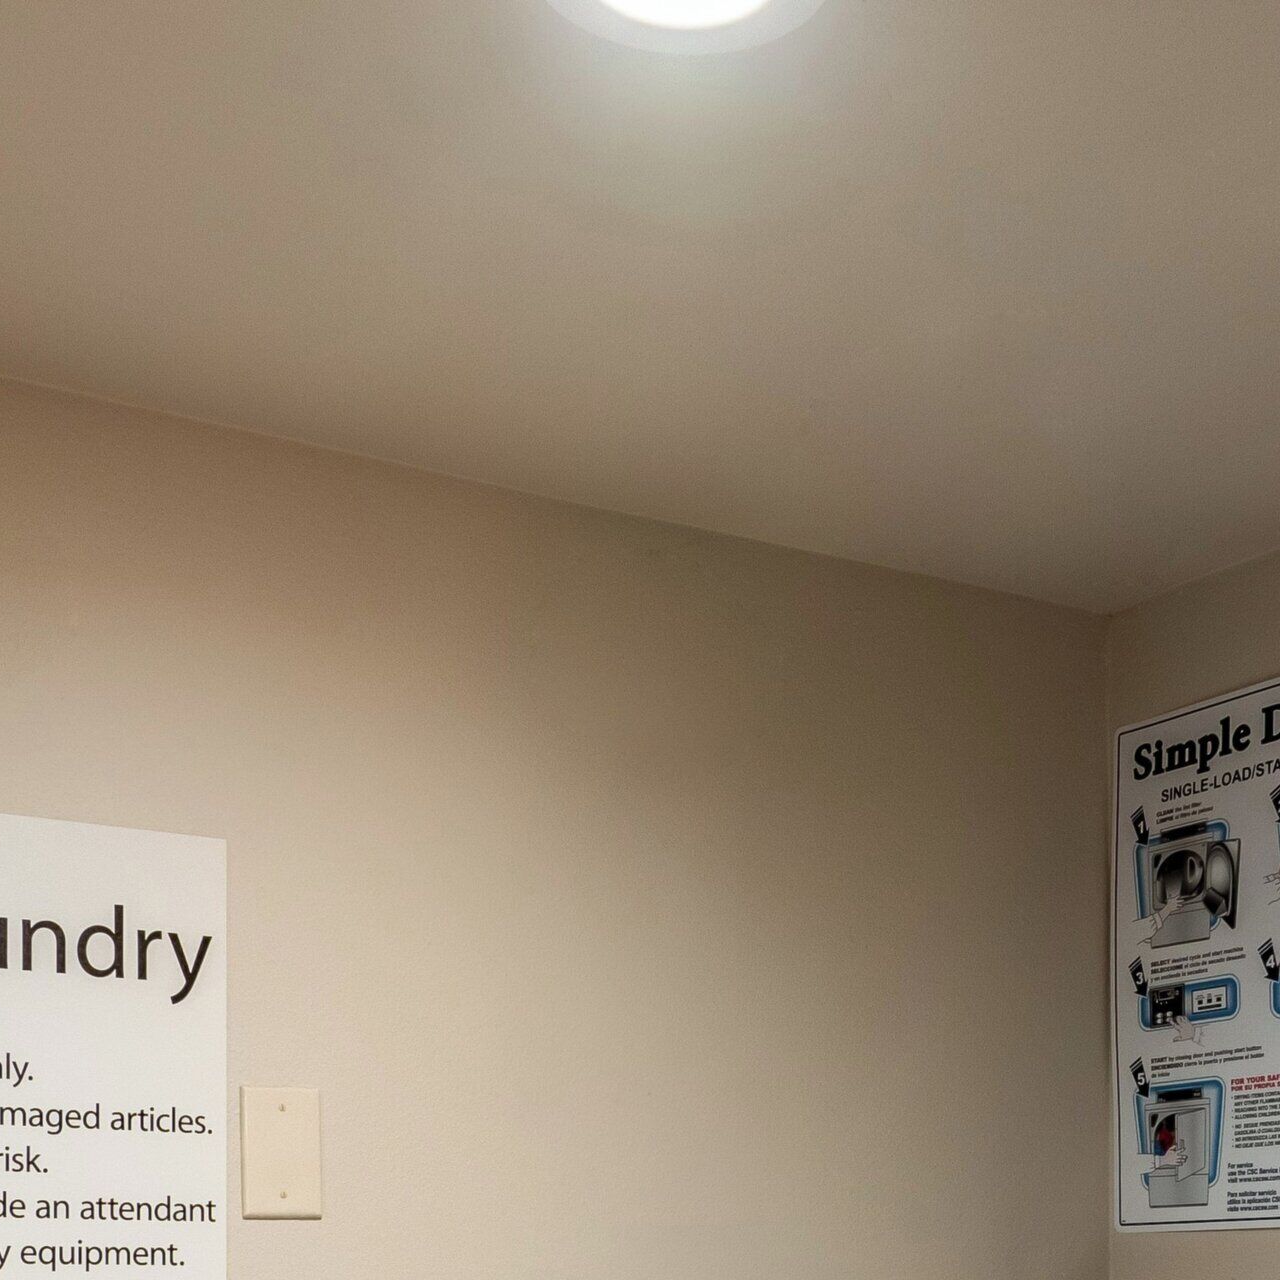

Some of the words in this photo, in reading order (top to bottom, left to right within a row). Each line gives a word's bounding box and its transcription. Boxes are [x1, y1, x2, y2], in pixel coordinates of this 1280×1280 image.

[1132, 716, 1251, 780] Simple
[1137, 822, 1146, 836] 1
[1265, 955, 1275, 969] 4
[1135, 972, 1144, 985] 3
[1137, 1072, 1145, 1085] 5
[1230, 1077, 1244, 1085] FOR
[1246, 1075, 1265, 1083] YOUR
[110, 1106, 212, 1134] articles.
[35, 1199, 69, 1219] an
[79, 1194, 216, 1222] attendant
[20, 1239, 184, 1272] equipment.
